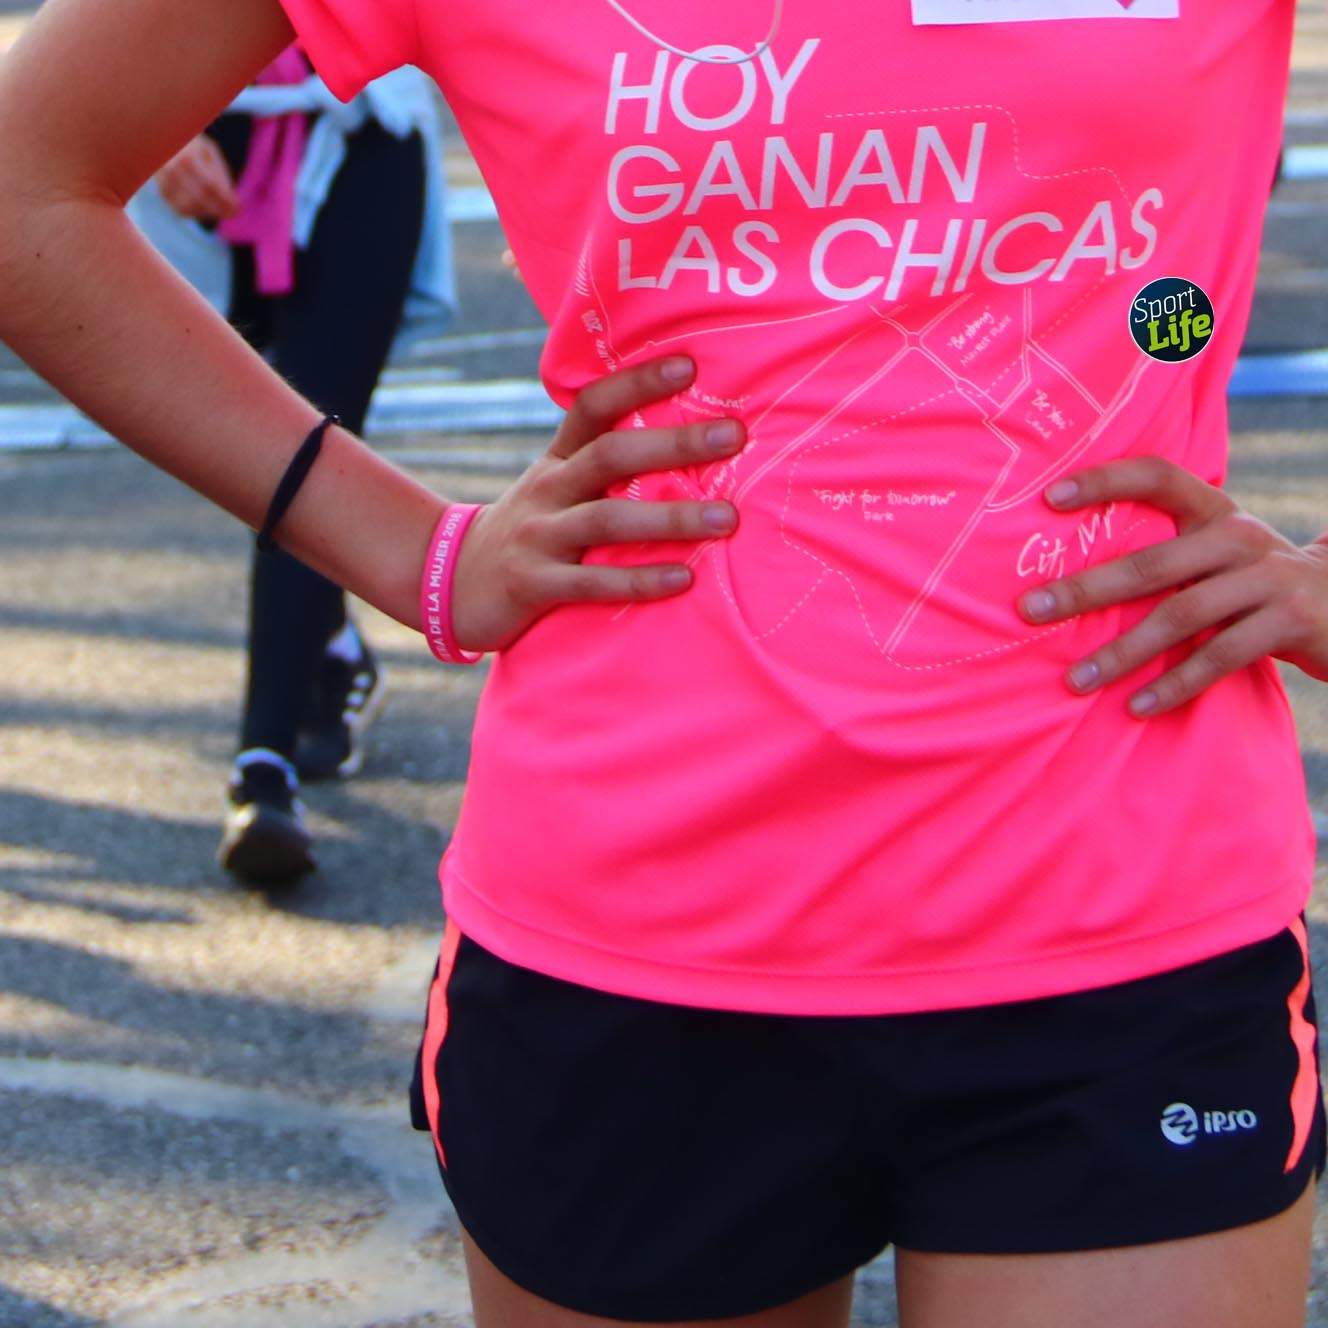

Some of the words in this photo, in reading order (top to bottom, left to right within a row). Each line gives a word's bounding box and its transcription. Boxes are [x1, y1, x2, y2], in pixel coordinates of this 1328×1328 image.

[604, 38, 821, 135] HOY
[607, 122, 988, 224] GANAN
[617, 220, 780, 297] LAS
[809, 188, 1164, 301] CHICAS
[1134, 286, 1197, 323] Sport
[1147, 309, 1212, 352] Life
[429, 539, 451, 588] MUJER
[427, 592, 441, 612] LA
[428, 615, 442, 635] DE
